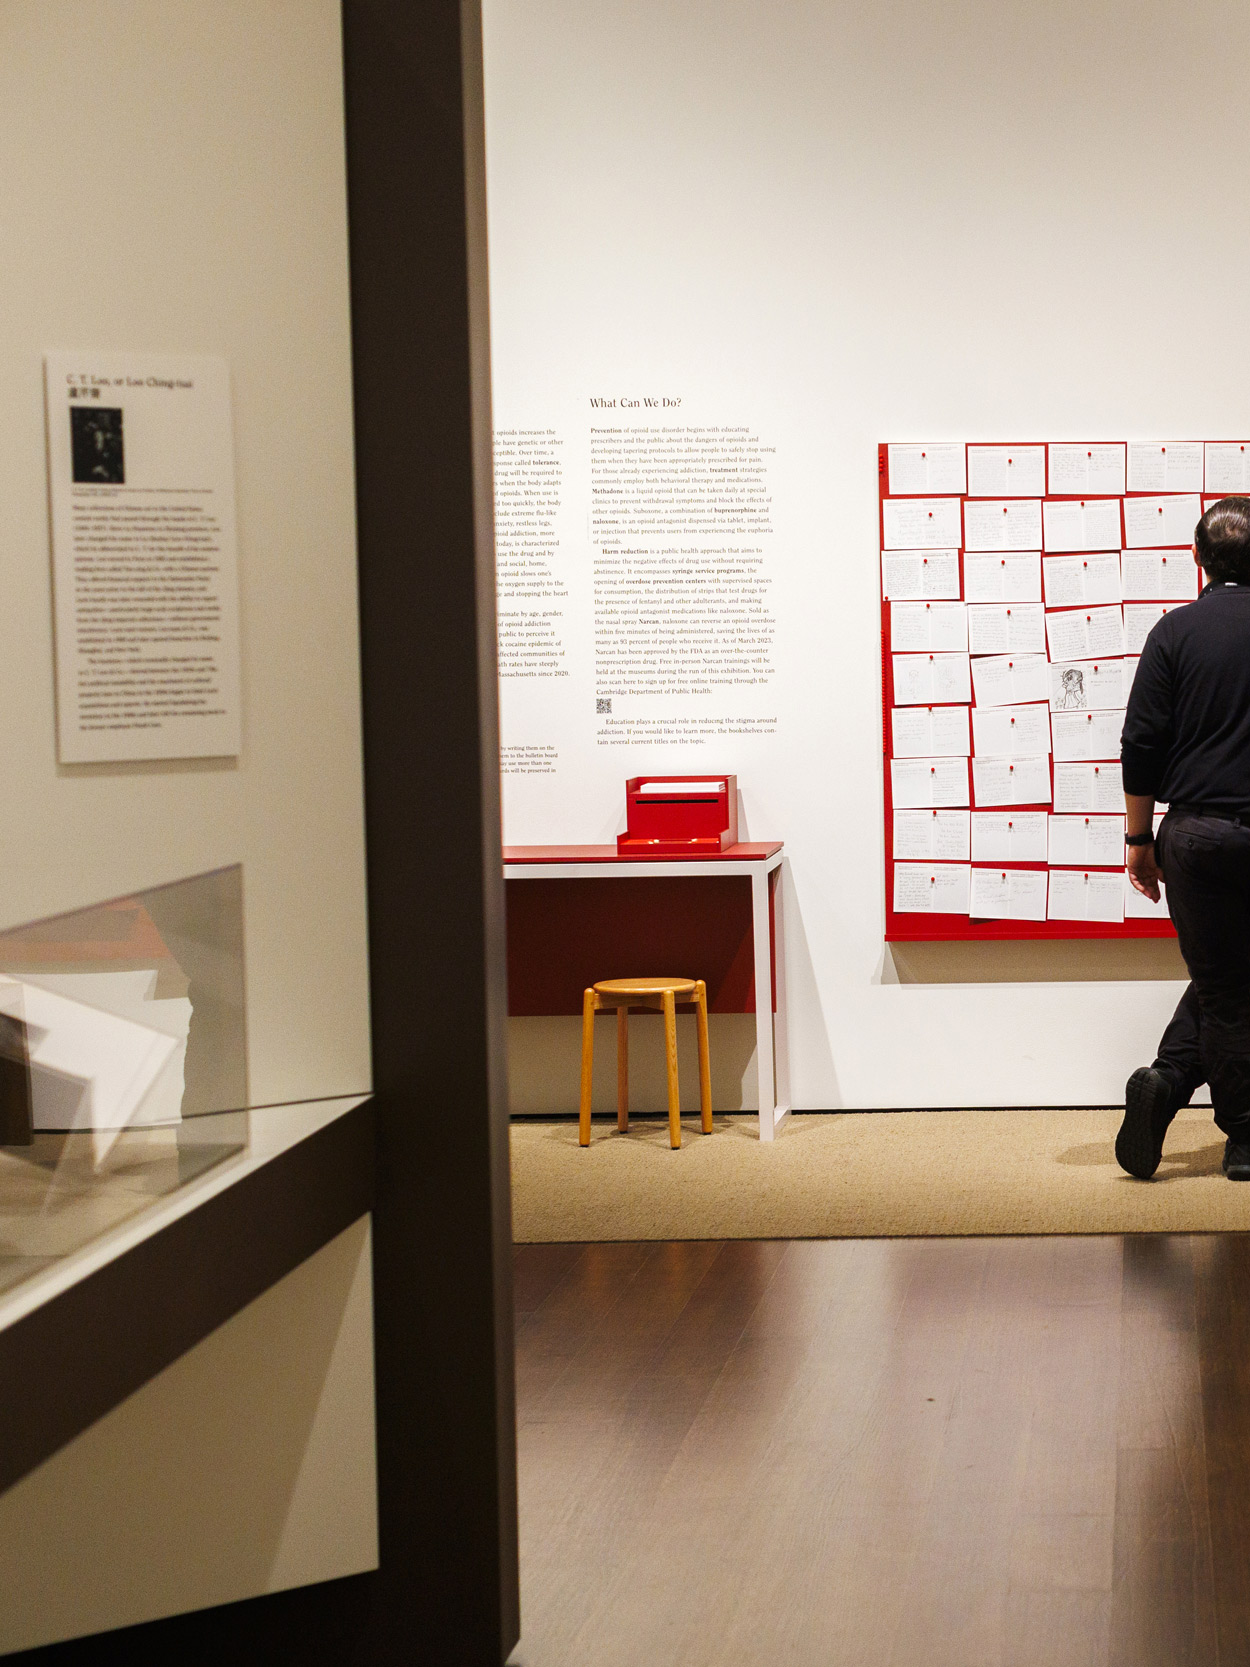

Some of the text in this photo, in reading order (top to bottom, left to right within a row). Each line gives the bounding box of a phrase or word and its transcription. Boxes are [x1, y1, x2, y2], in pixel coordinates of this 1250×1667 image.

[590, 398, 682, 408] What Can We Do?
[496, 427, 556, 438] opioids increases the
[590, 426, 623, 434] Prevention
[623, 426, 630, 434] of
[630, 426, 649, 436] opioid
[661, 425, 685, 433] disorder
[686, 425, 706, 436] begins
[706, 425, 720, 433] with
[720, 425, 750, 435] educating
[502, 438, 516, 446] have
[517, 438, 539, 448] genetic
[547, 437, 564, 445] other
[590, 446, 623, 457] developing
[622, 447, 648, 456] tapering
[648, 446, 676, 456] protocols
[676, 446, 684, 454] to
[684, 445, 700, 454] allow
[700, 445, 720, 456] people
[728, 445, 745, 456] safely
[746, 446, 759, 455] stop
[759, 445, 777, 455] using
[514, 458, 532, 466] called
[591, 467, 601, 475] For
[602, 466, 619, 475] those
[619, 466, 641, 477] already
[641, 467, 679, 476] experiencing
[709, 466, 739, 474] treatment
[739, 466, 768, 476] strategies
[591, 476, 622, 487] commonly
[623, 476, 645, 487] employ
[645, 476, 660, 484] both
[660, 476, 691, 484] behavioral
[691, 476, 714, 486] therapy
[714, 475, 726, 484] and
[621, 517, 628, 525] is
[636, 517, 656, 527] opioid
[656, 517, 687, 527] antagonist
[687, 516, 717, 527] dispensed
[514, 539, 560, 547] is characterized
[601, 547, 619, 555] Harm
[620, 547, 649, 555] reduction
[649, 547, 655, 555] is
[660, 546, 679, 557] public
[680, 546, 699, 554] health
[699, 546, 727, 556] approach
[727, 546, 740, 554] that
[740, 546, 755, 554] aims
[755, 546, 763, 554] to
[627, 567, 633, 575] It
[633, 569, 671, 577] encompasses
[671, 567, 694, 577] syringe
[747, 566, 757, 574] the
[593, 578, 618, 588] opening
[618, 577, 625, 585] of
[625, 577, 652, 585] overdose
[652, 577, 684, 587] prevention
[707, 576, 721, 584] with
[722, 576, 753, 586] supervised
[753, 578, 773, 586] spaces
[503, 589, 569, 599] and stopping the heart
[497, 619, 552, 630] of opioid addiction
[498, 629, 517, 640] public
[525, 630, 550, 639] perceive
[550, 629, 556, 637] it
[595, 647, 616, 655] Narcan
[616, 647, 628, 655] has
[628, 647, 643, 655] been
[643, 647, 670, 657] approved
[670, 647, 678, 657] by
[678, 647, 689, 655] the
[689, 646, 703, 655] FDA
[720, 646, 769, 654] over-the-counter
[595, 687, 628, 698] Cambridge
[628, 687, 663, 697] Department
[664, 687, 671, 695] of
[671, 687, 690, 695] Public
[596, 738, 609, 746] tain
[609, 737, 630, 746] several
[653, 737, 669, 745] titles
[678, 737, 689, 745] the
